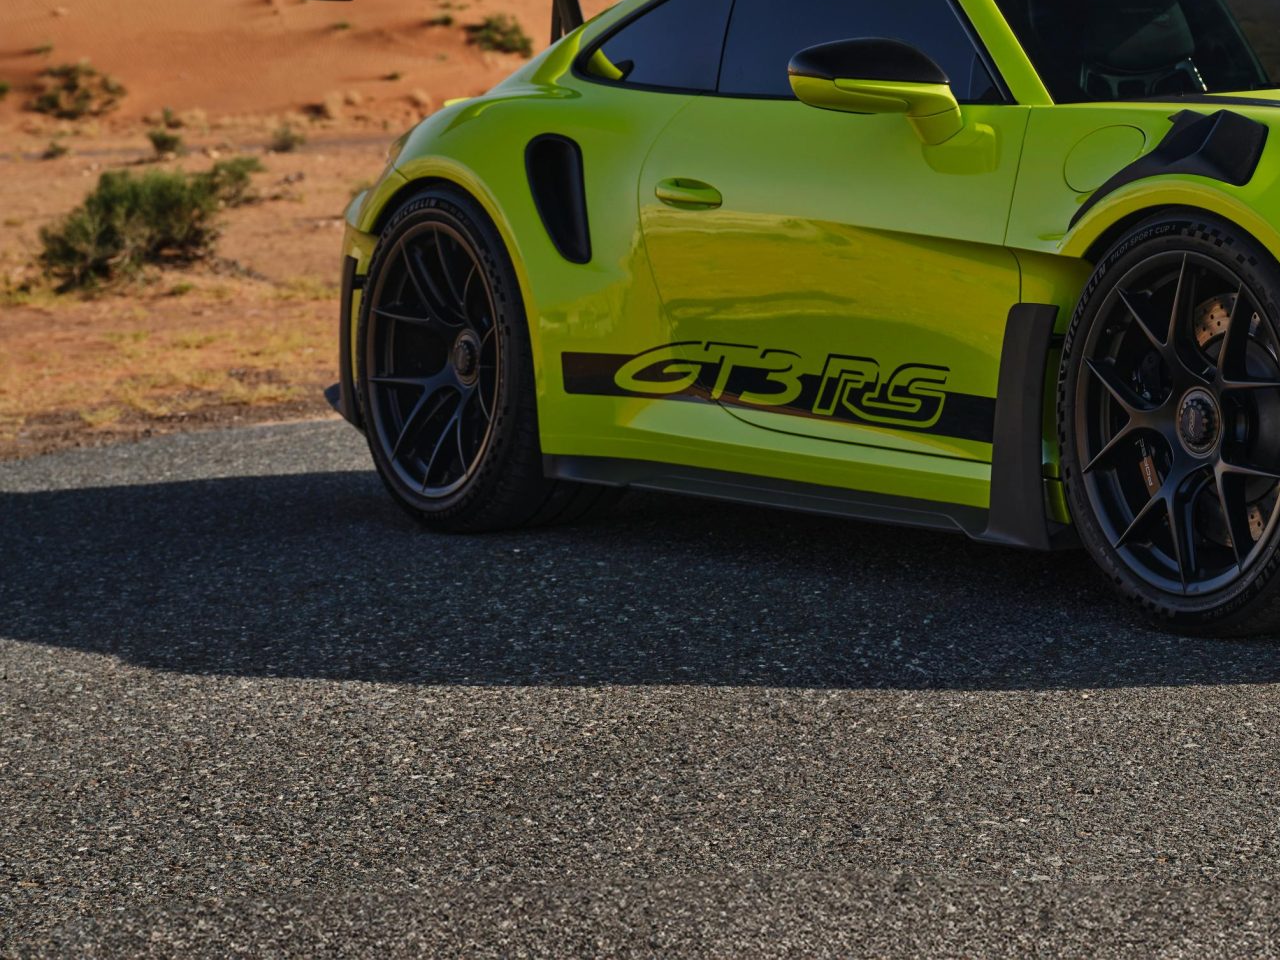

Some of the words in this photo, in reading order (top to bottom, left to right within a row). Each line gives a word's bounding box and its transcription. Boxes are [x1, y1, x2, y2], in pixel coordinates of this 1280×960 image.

[1065, 263, 1107, 353] MICHELIN
[1110, 242, 1129, 263] PILOT
[1130, 229, 1153, 246] SPORT
[1155, 225, 1170, 234] CUP
[614, 341, 801, 406] GT3
[812, 353, 951, 428] RS
